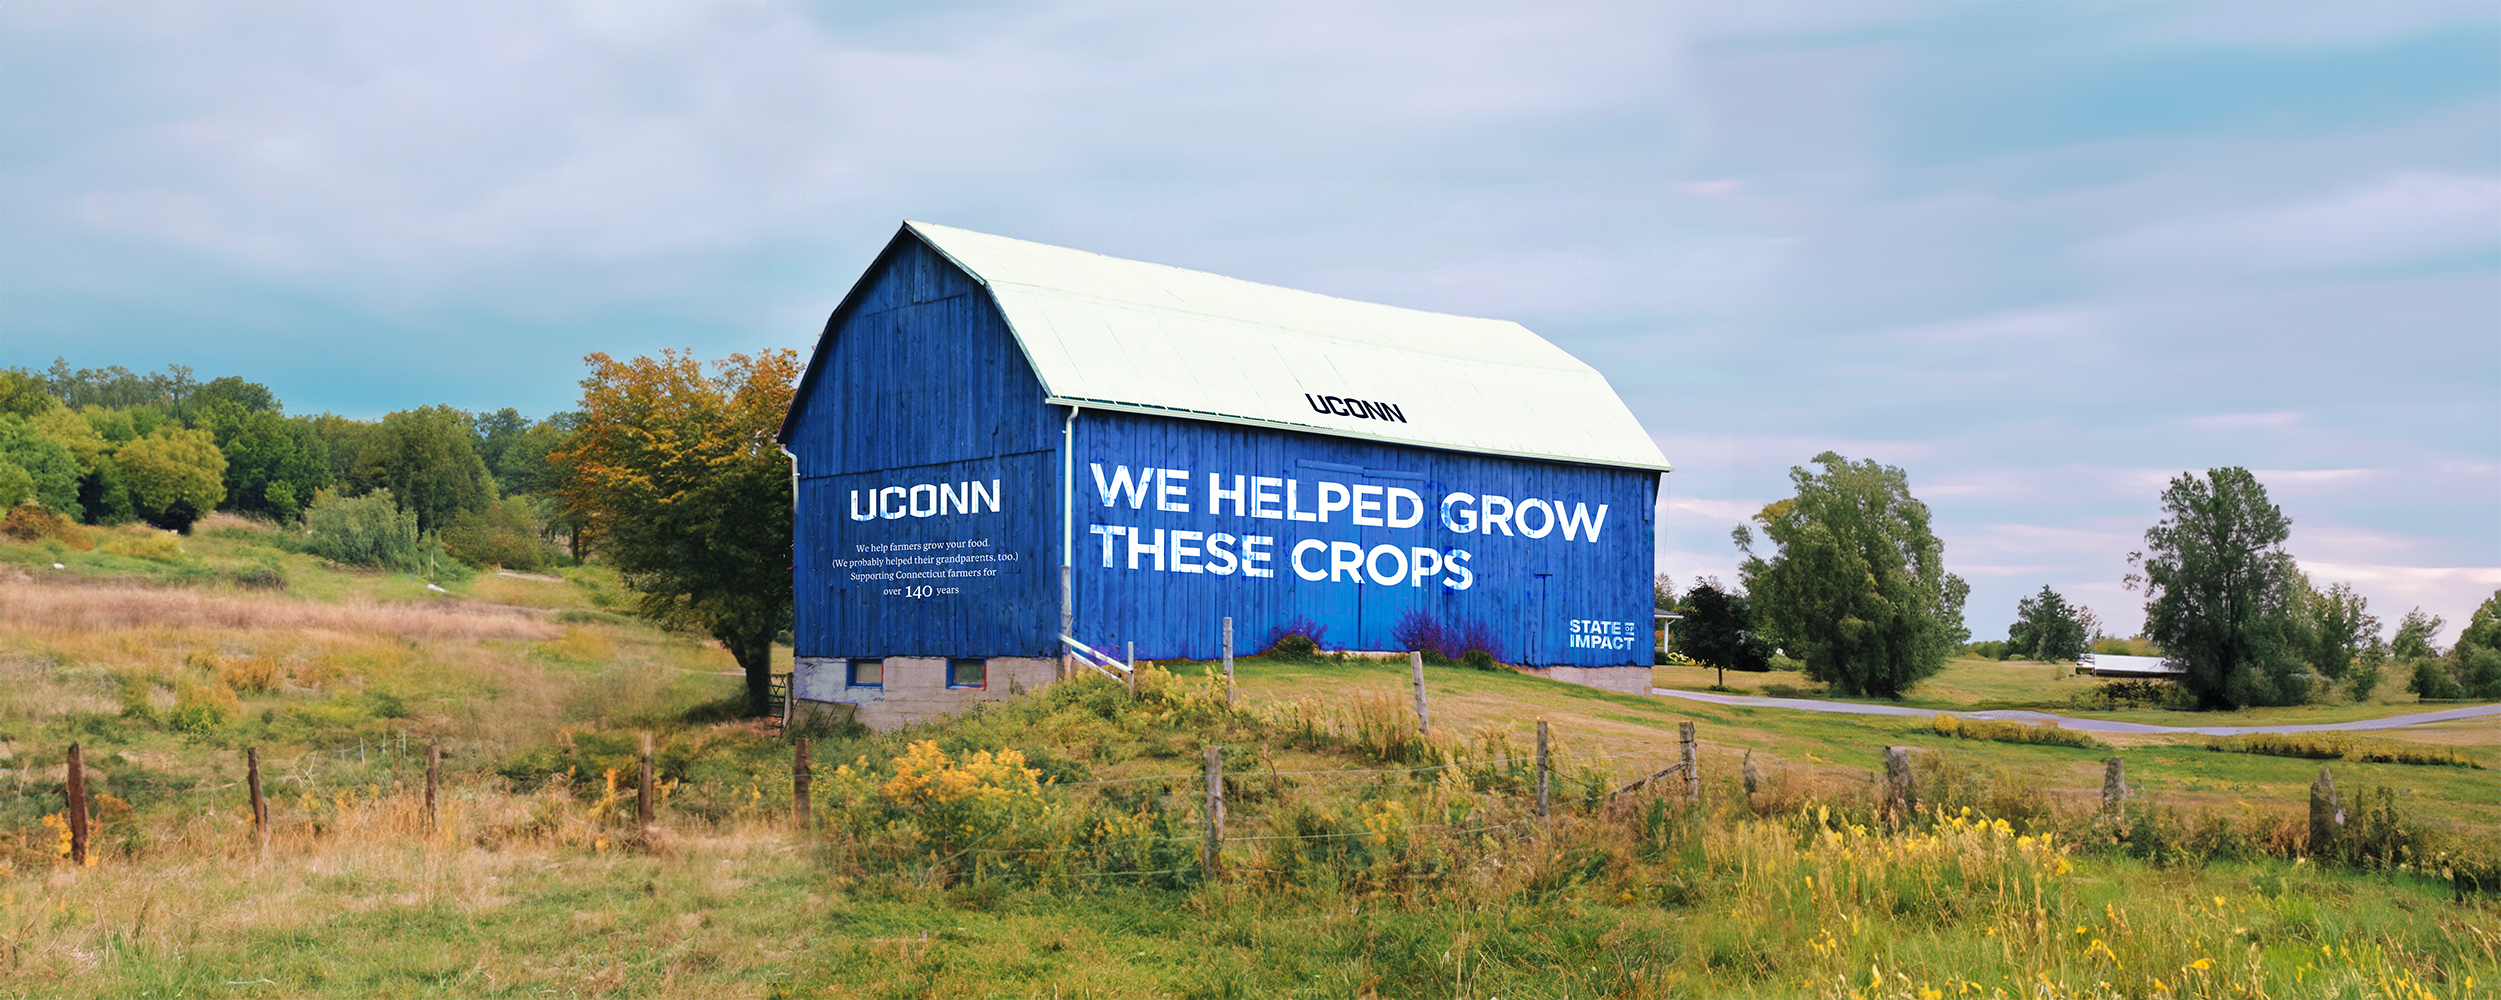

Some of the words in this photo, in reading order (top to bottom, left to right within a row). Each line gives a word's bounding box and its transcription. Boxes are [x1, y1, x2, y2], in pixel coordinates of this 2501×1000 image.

[1305, 394, 1407, 423] UCONN
[851, 479, 1000, 521] UCONN
[1090, 463, 1189, 512] WE
[1210, 473, 1423, 528] HELPED
[1441, 492, 1608, 542] GROW
[856, 544, 870, 553] We
[870, 543, 889, 554] help
[889, 542, 922, 552] farmers
[922, 542, 945, 552] grow
[945, 541, 967, 551] your
[967, 537, 991, 548] food.
[832, 559, 848, 569] (We
[849, 557, 885, 569] probably
[885, 555, 913, 567] helped
[914, 555, 935, 565] their
[935, 553, 996, 566] grandparents,
[997, 551, 1019, 562] too.)
[1090, 525, 1273, 577] THESE
[1291, 539, 1473, 591] CROPS
[850, 571, 895, 583] Supporting
[895, 569, 946, 580] Connecticut
[947, 568, 982, 578] farmers
[983, 567, 997, 577] for
[883, 587, 902, 596] over
[905, 584, 933, 600] 140
[936, 587, 960, 597] years
[1570, 620, 1621, 635] STATE
[1570, 634, 1634, 649] IMPACT
